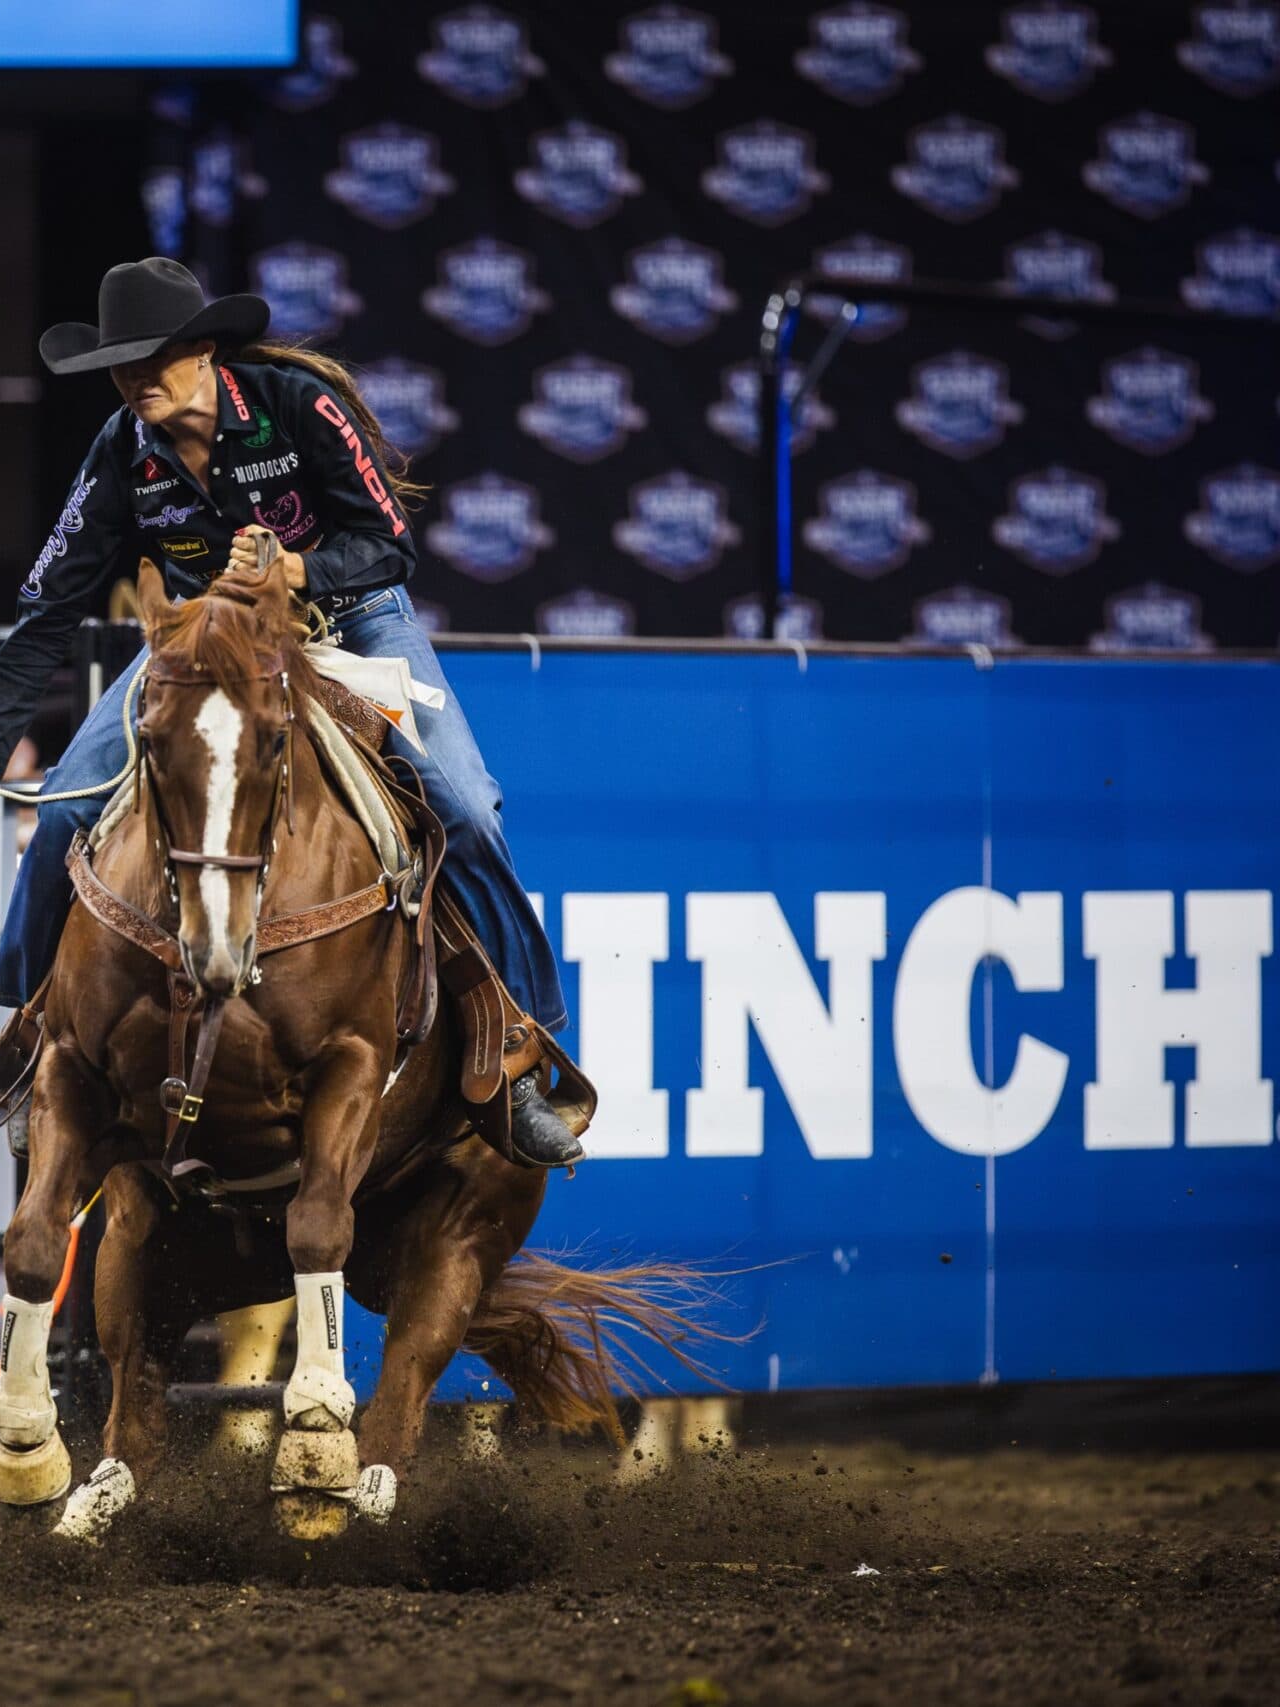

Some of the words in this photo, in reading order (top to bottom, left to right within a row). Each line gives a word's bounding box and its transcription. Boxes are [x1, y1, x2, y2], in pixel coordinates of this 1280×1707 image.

[135, 480, 172, 496] TWISTED
[171, 477, 180, 487] X
[233, 451, 299, 484] MURDOCH'S
[314, 394, 406, 537] CINCH
[530, 886, 1274, 1160] INCH
